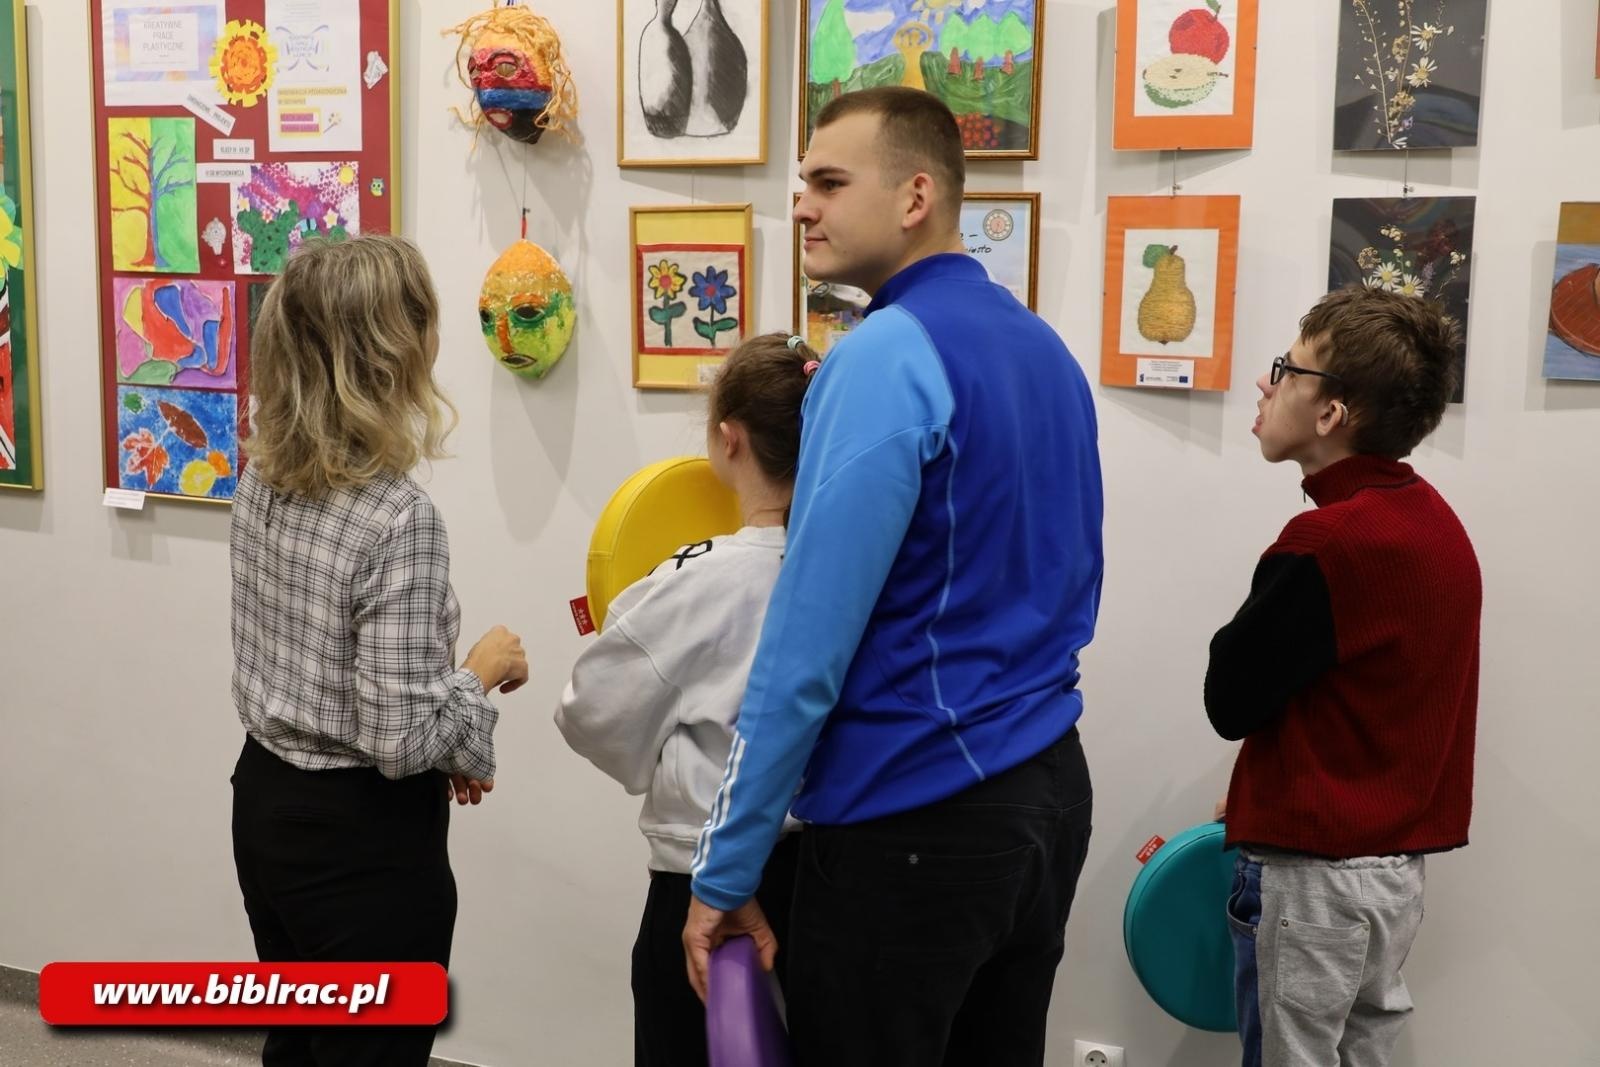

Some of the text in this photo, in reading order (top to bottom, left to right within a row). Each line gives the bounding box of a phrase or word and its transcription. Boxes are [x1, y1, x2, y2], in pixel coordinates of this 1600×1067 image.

[143, 20, 183, 30] KREATYWNE
[152, 31, 174, 40] PRACE
[143, 41, 184, 51] PLASTYCZNE
